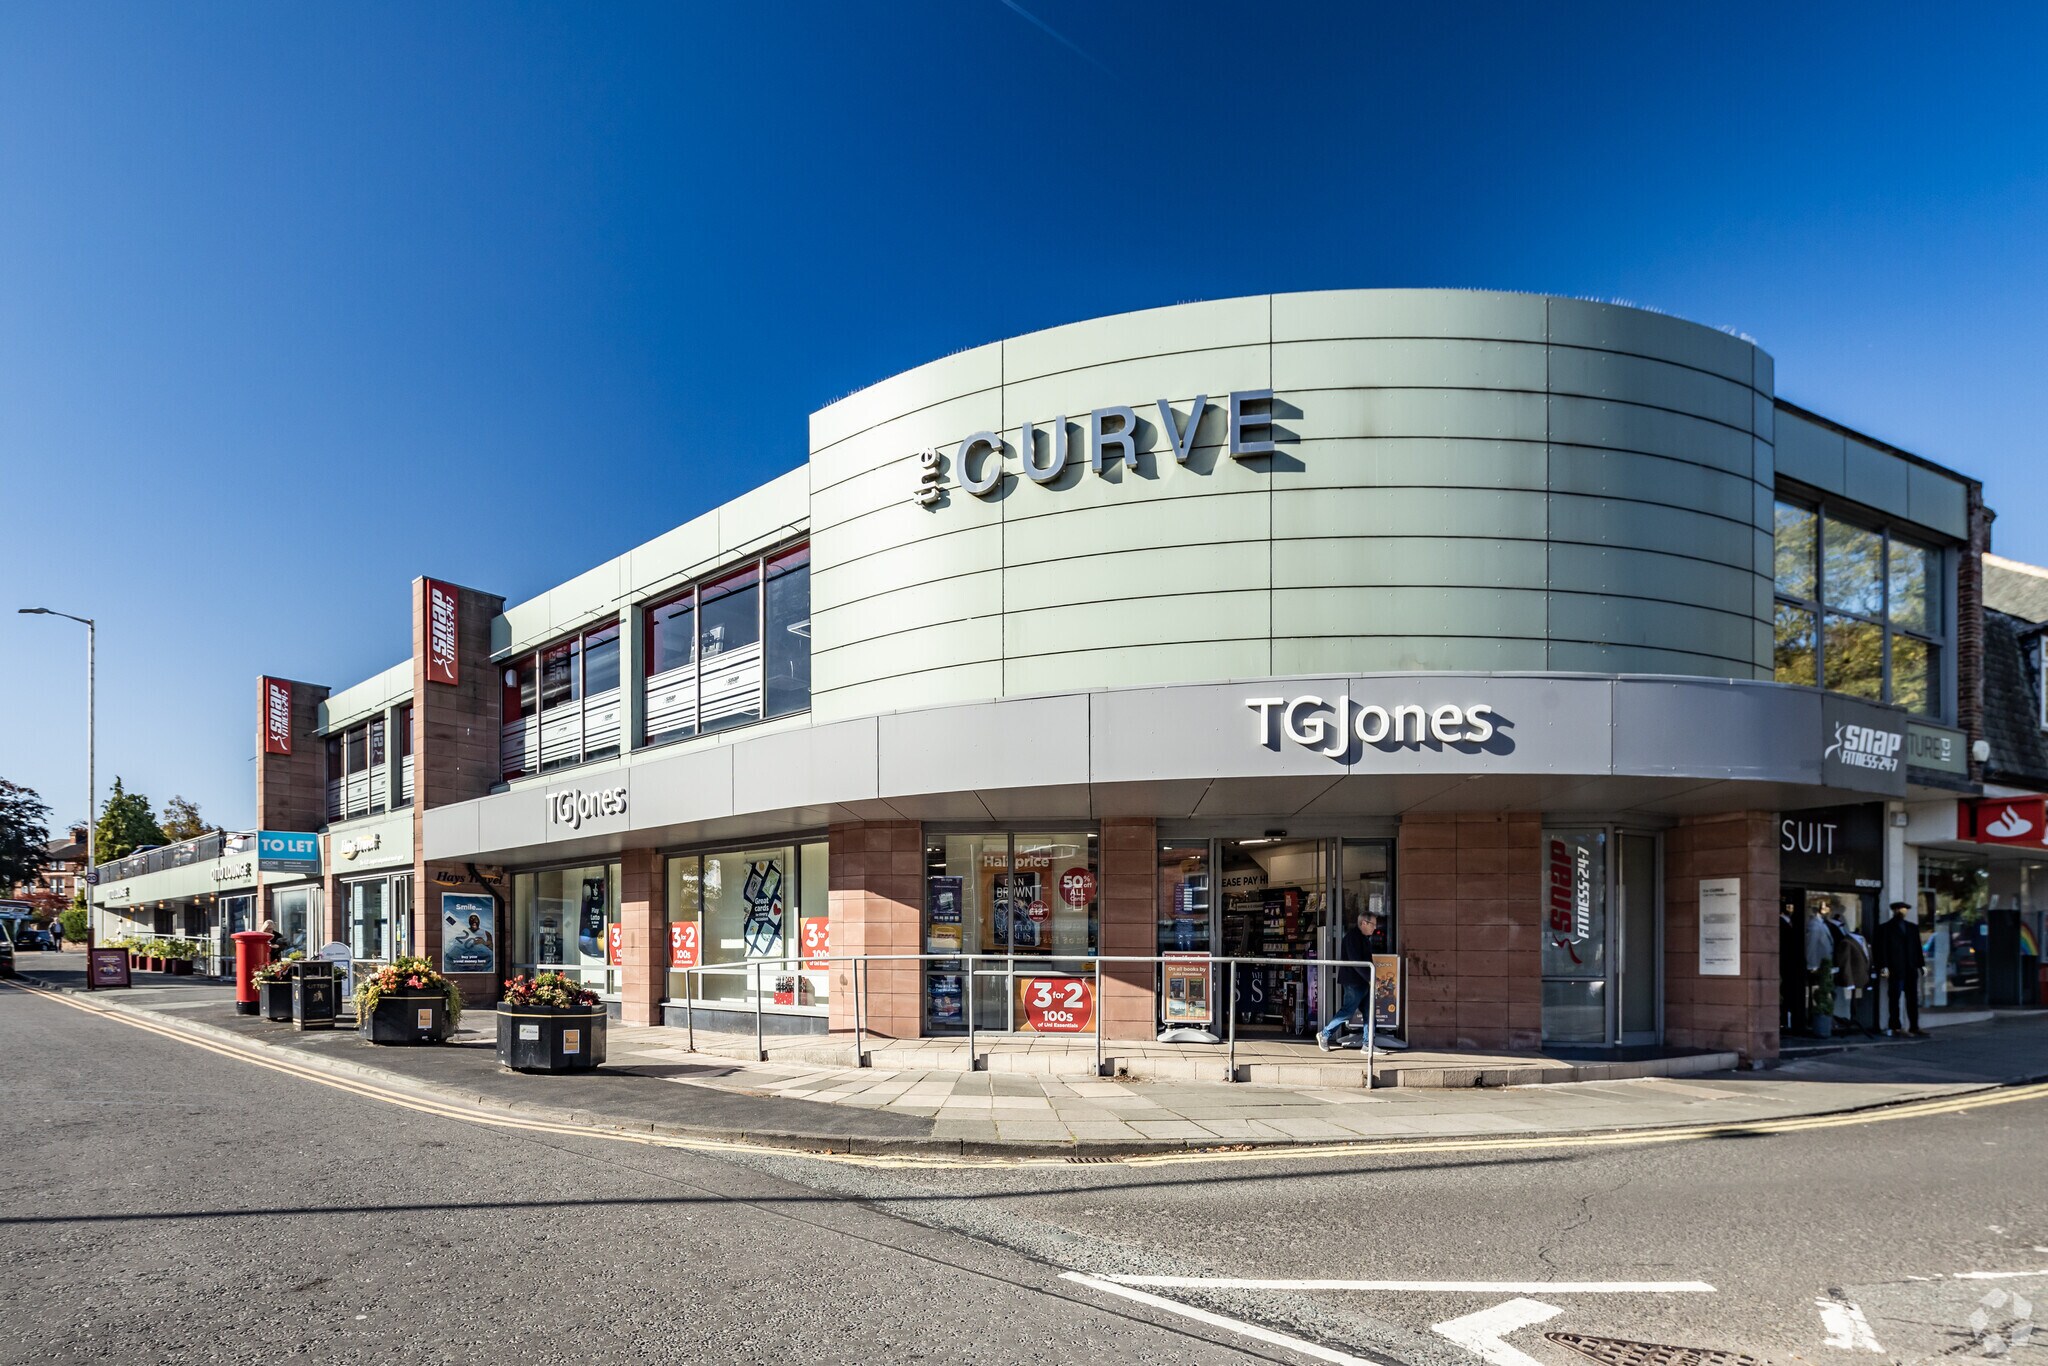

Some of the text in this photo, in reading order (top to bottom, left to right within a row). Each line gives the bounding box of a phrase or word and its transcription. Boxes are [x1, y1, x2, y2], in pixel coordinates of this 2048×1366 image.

[913, 389, 1275, 508] the CURVE
[1245, 695, 1493, 758] TGJones
[1843, 724, 1903, 756] snap
[546, 786, 627, 828] TGJones
[1781, 819, 1838, 855] SUIT
[261, 839, 314, 853] TO LET
[1015, 856, 1049, 869] price
[87, 874, 97, 882] 20
[436, 872, 503, 885] Hays Trvel
[1222, 878, 1242, 887] EASE
[1243, 876, 1258, 885] PAY
[1551, 840, 1571, 933] snap
[996, 887, 1033, 898] BRWN
[1069, 888, 1085, 896] ALL
[754, 897, 769, 905] Great
[754, 904, 769, 912] cards
[612, 927, 620, 947] 3
[672, 928, 681, 948] 3
[685, 927, 695, 947] 2
[806, 924, 818, 947] 3
[676, 950, 690, 959] 100s
[1033, 982, 1083, 1008] 3 for 2
[1251, 979, 1263, 1003] S
[1042, 1011, 1073, 1022] 100s
